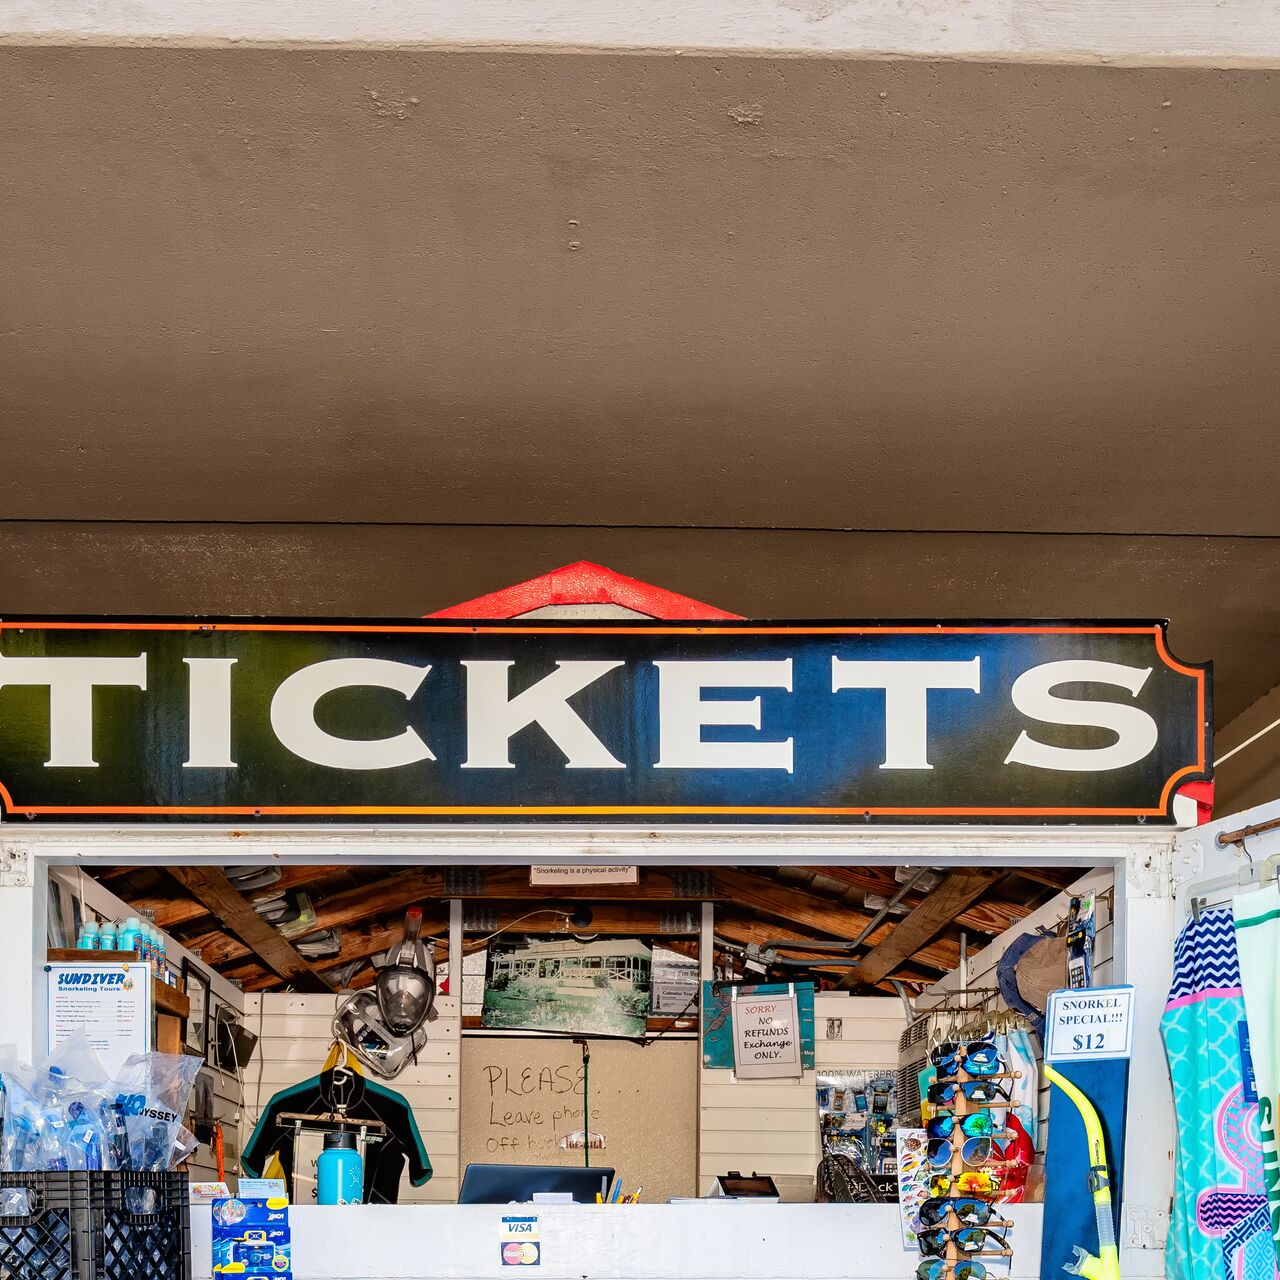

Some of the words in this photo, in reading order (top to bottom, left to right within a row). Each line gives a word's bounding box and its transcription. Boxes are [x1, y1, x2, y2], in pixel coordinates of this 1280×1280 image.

[533, 866, 568, 876] "Snorkeling
[582, 866, 607, 875] physical
[608, 865, 631, 875] activity"
[57, 973, 126, 985] SUNDIVER
[745, 1004, 784, 1015] SORRY...
[1063, 998, 1121, 1011] SNORKEL
[758, 1017, 773, 1025] NO
[1058, 1013, 1123, 1025] SPECIAL!!!
[744, 1027, 789, 1038] REFUNDS
[744, 1037, 792, 1049] Exchange
[1072, 1033, 1105, 1051] $12
[754, 1051, 782, 1060] ONLY.
[489, 1102, 545, 1127] Leave
[486, 1137, 520, 1154] Off
[508, 1223, 532, 1233] VISA
